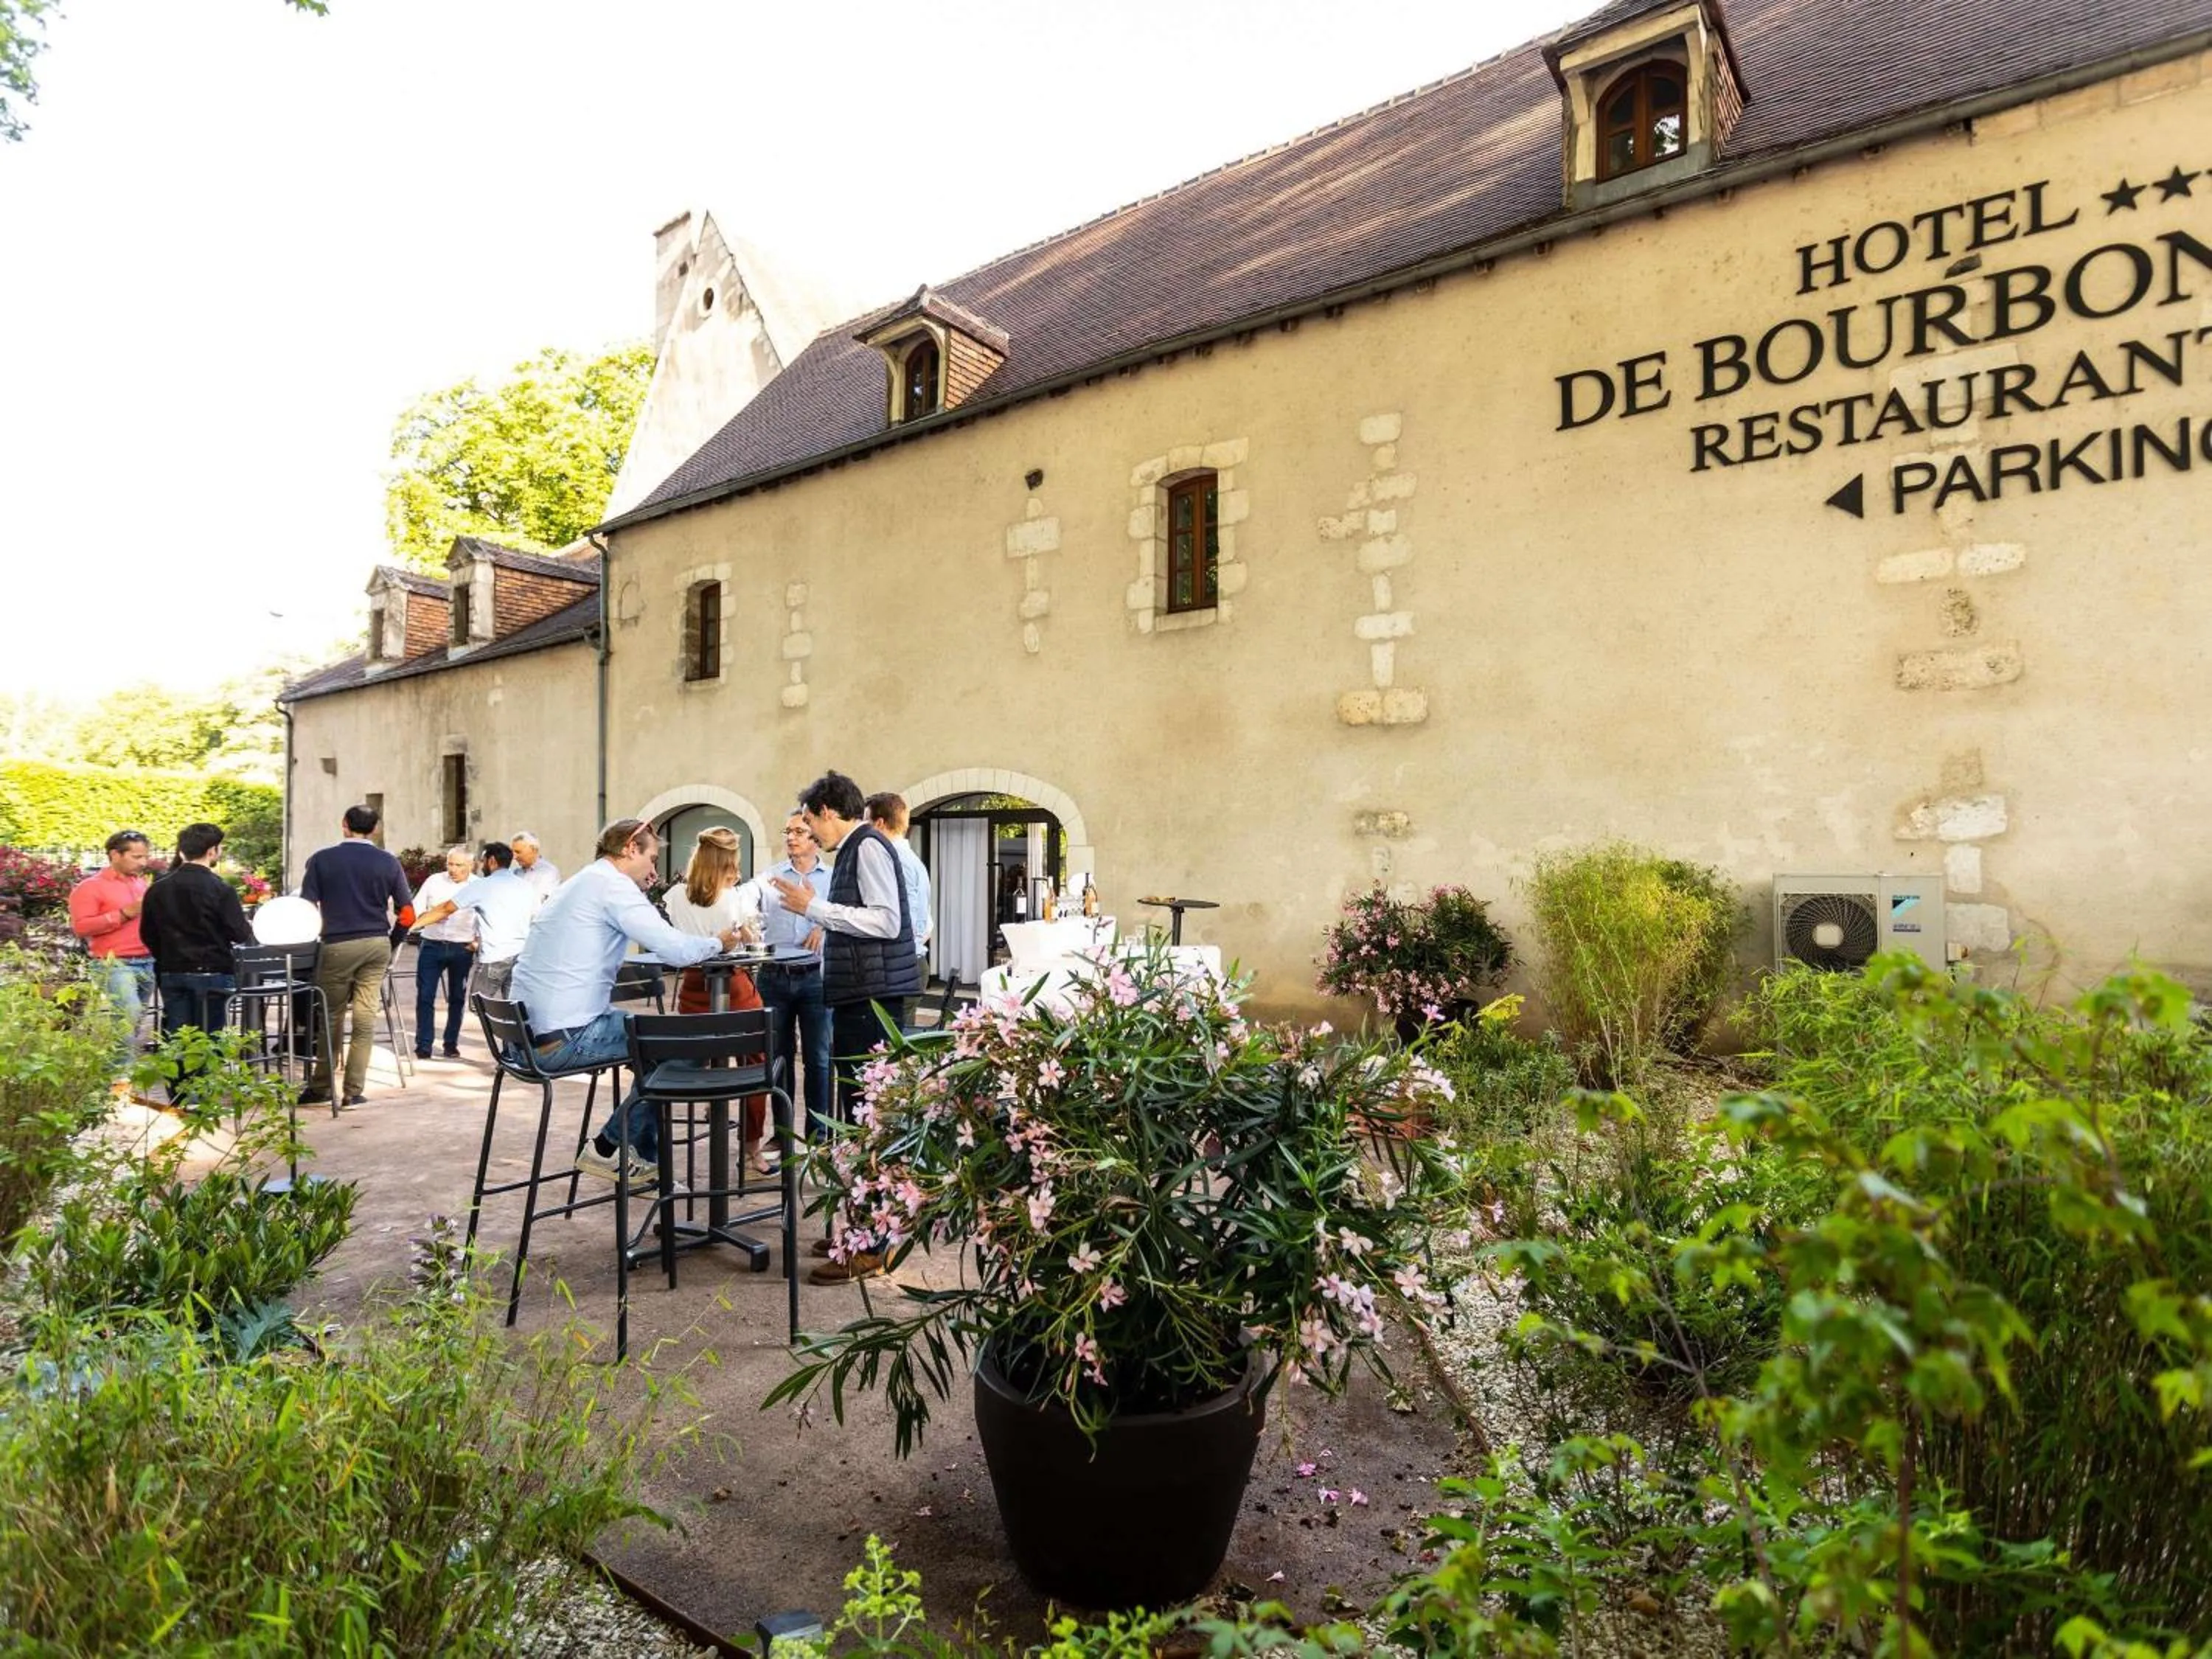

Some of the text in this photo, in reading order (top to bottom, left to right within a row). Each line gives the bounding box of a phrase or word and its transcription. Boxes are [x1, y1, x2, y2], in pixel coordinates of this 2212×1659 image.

[1795, 179, 2079, 296] HOTEL
[1554, 350, 1672, 432] DE
[1891, 417, 2212, 515] PARKIN
